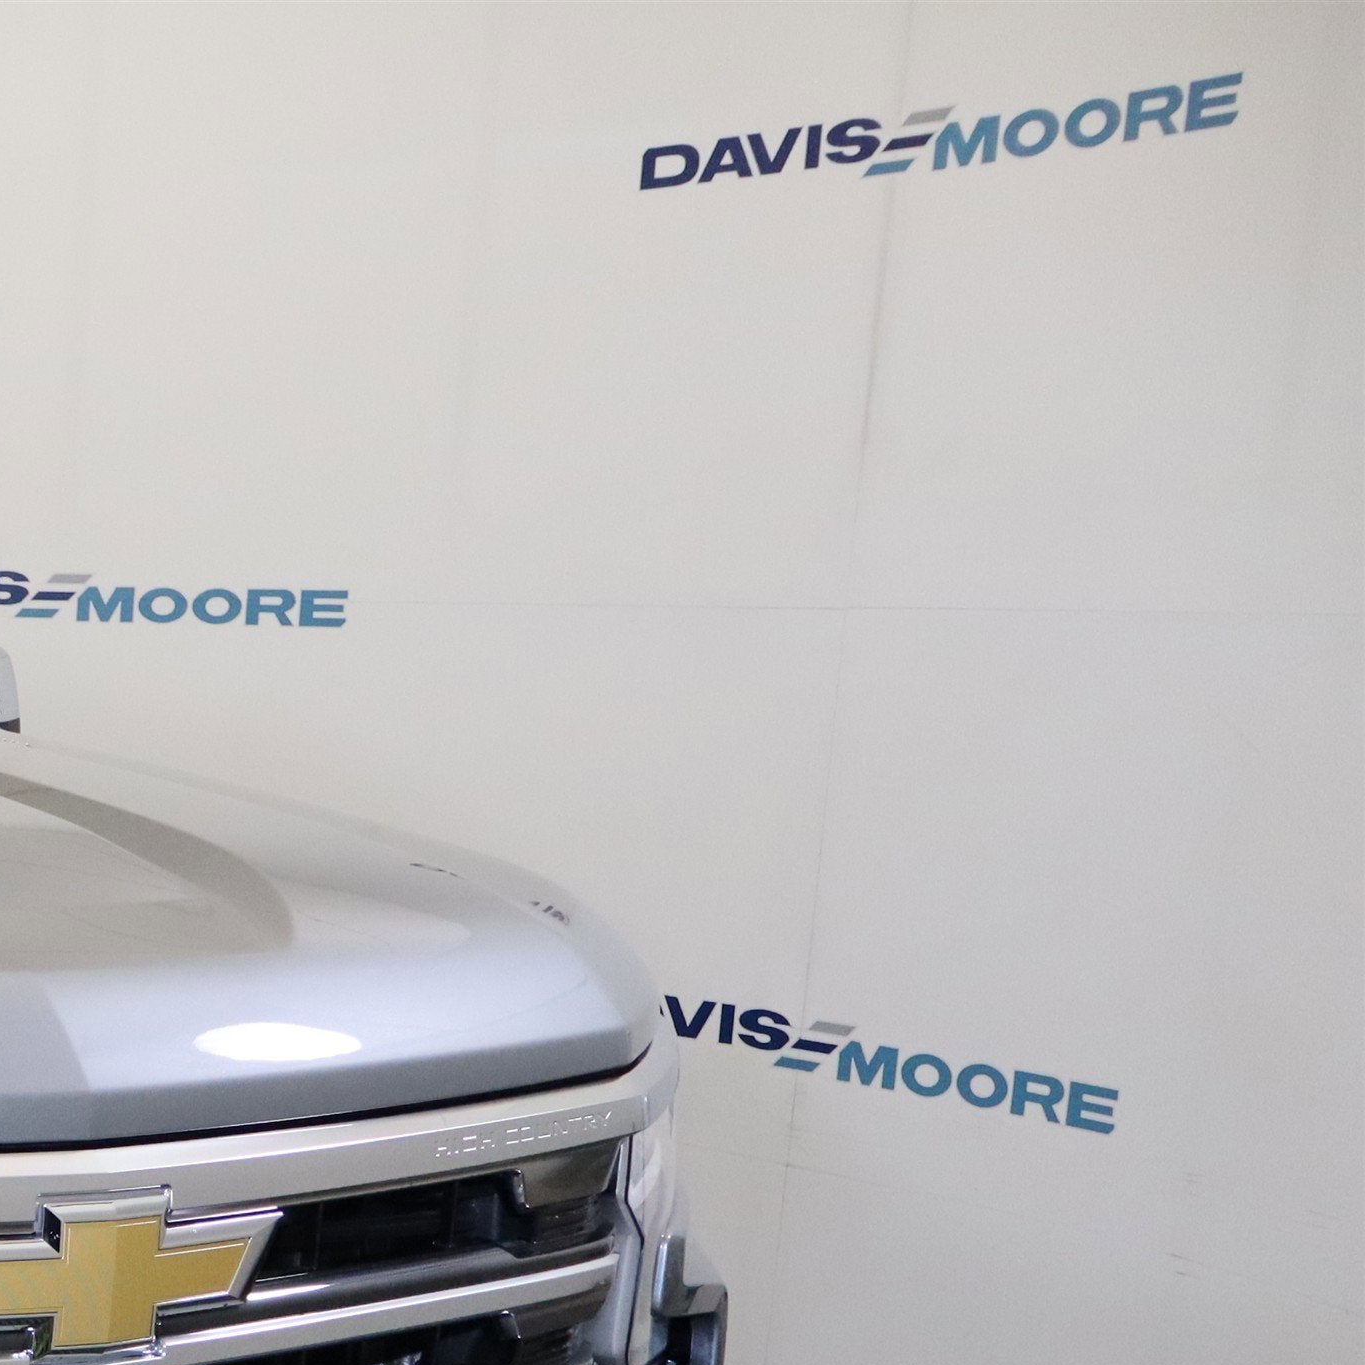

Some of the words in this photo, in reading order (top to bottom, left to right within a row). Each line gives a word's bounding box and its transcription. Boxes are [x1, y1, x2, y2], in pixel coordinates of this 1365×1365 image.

[639, 117, 883, 191] DAVIS
[932, 71, 1244, 171] MOORE
[75, 586, 349, 628] MOORE
[659, 994, 792, 1052] VIS
[836, 1040, 1120, 1135] MOORE
